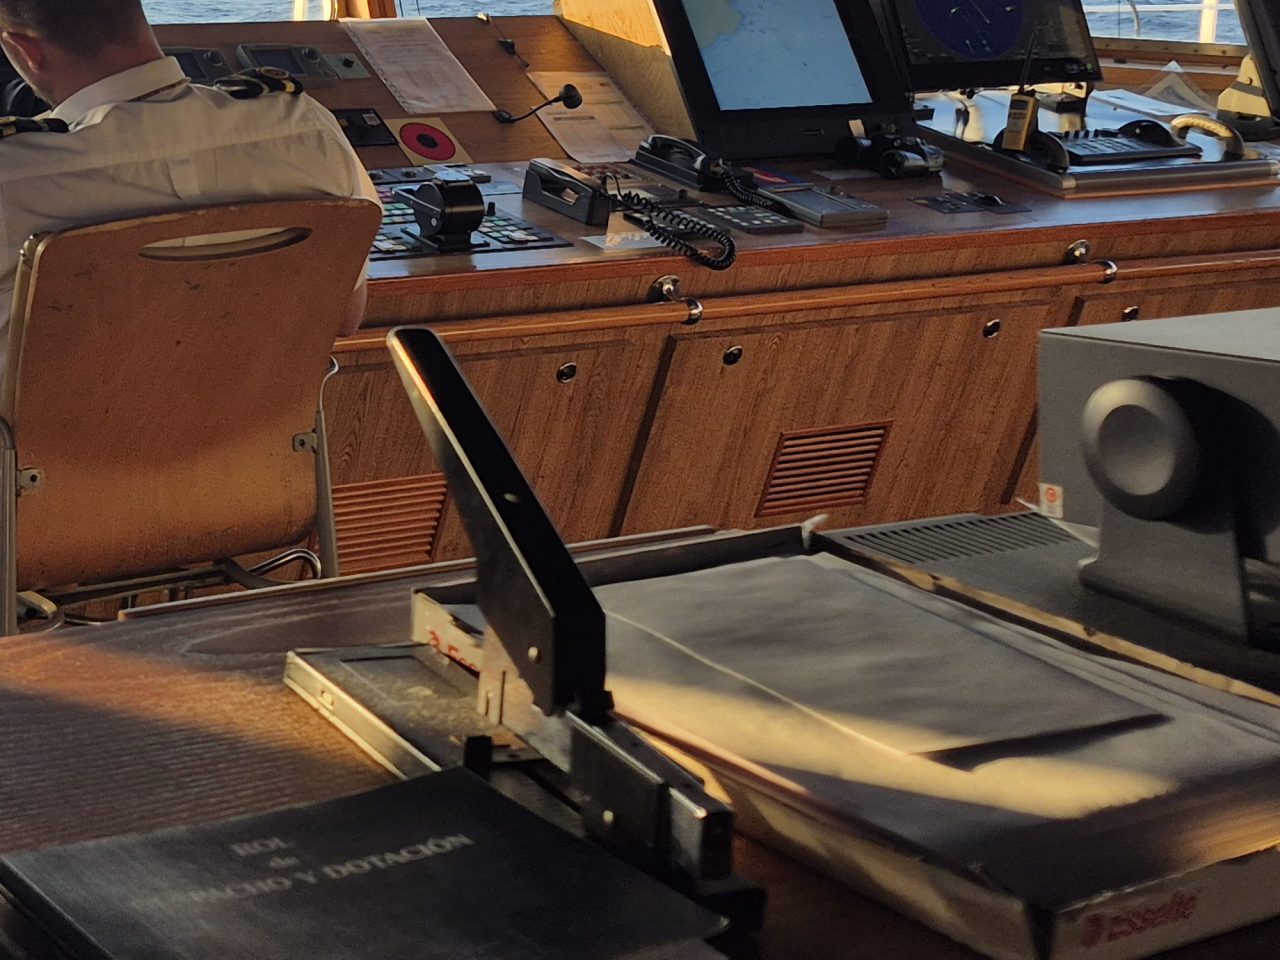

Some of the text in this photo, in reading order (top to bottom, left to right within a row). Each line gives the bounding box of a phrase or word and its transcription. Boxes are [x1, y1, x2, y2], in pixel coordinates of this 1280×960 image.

[231, 837, 292, 857] ROL
[294, 870, 318, 885] Y
[322, 833, 473, 880] DOTACIÓN
